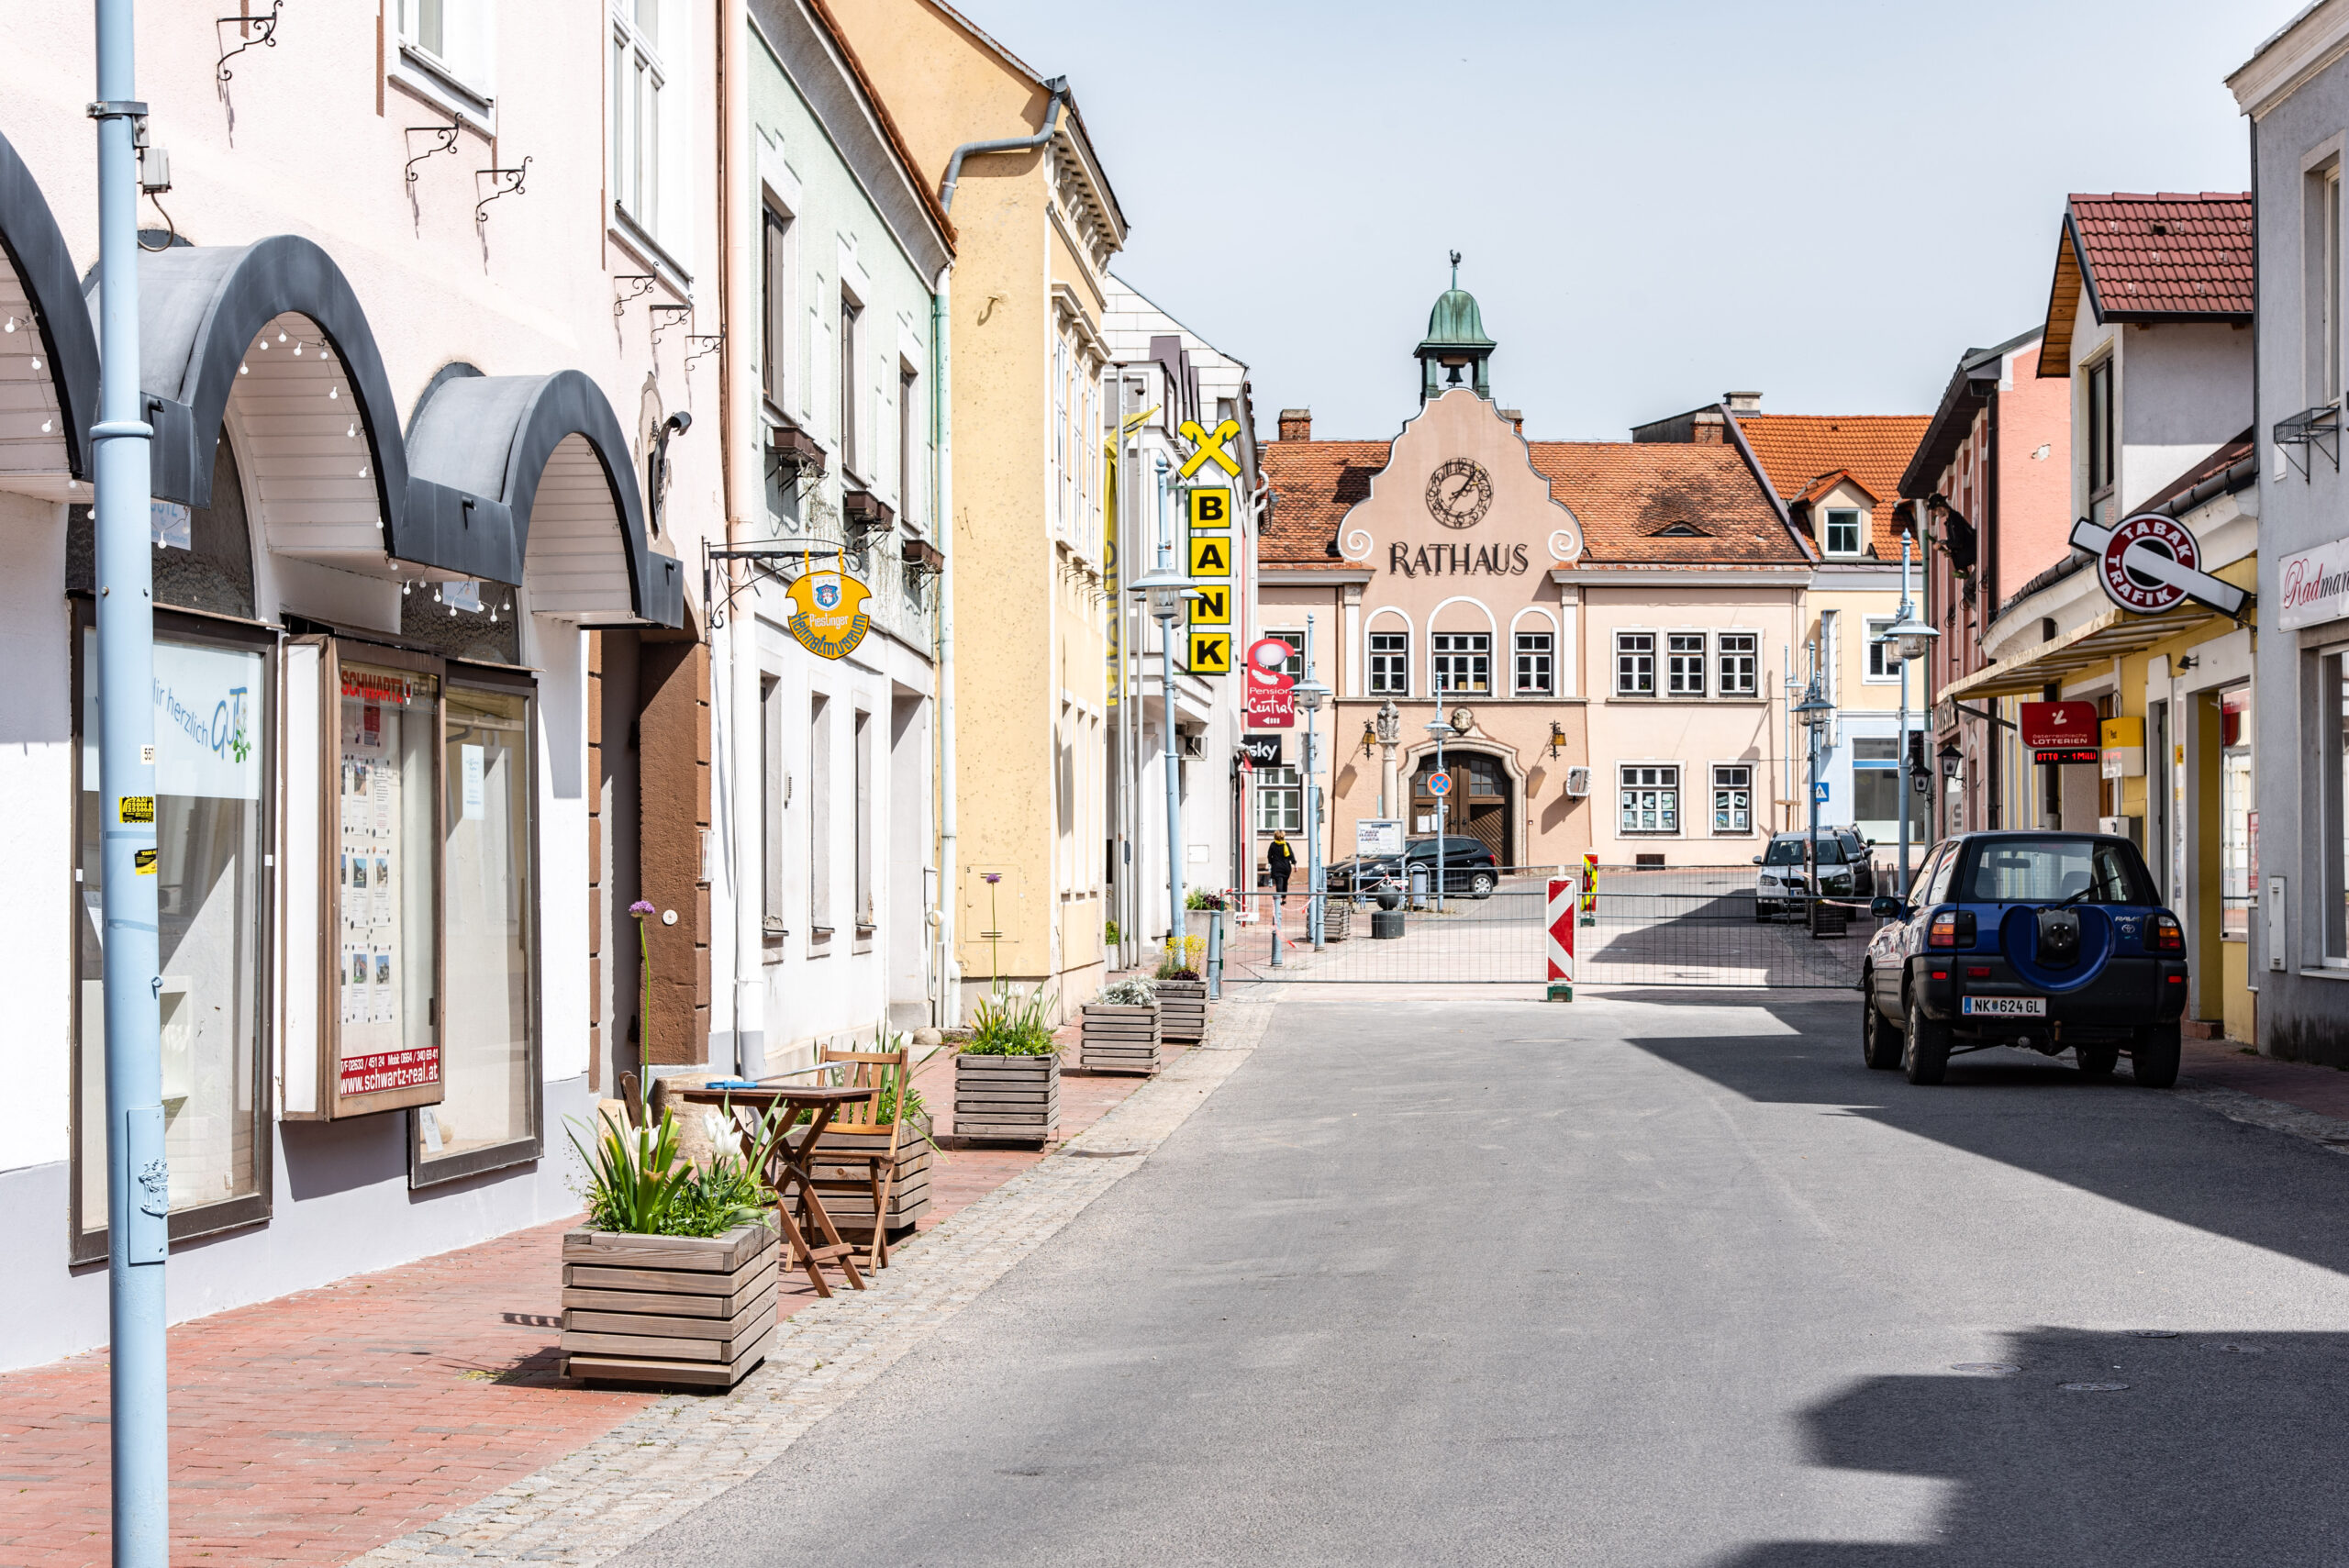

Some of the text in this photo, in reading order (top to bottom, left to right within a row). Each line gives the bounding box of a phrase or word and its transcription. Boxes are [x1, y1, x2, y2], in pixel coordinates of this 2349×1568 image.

[2121, 522, 2191, 559] TABAK
[1389, 541, 1530, 578] RATHAUS
[1197, 496, 1224, 664] BANK
[2108, 555, 2172, 606] TRAFIK
[789, 611, 867, 656] Heimatmuseum
[808, 613, 849, 629] Piestinger
[340, 670, 404, 704] SCHWARTZ
[167, 688, 208, 748] herzlich
[1248, 695, 1294, 715] Central
[1248, 741, 1277, 761] sky
[1975, 999, 2041, 1013] NK 624 GL
[348, 1058, 364, 1072] 02633
[368, 1056, 378, 1068] 451
[378, 1055, 385, 1067] 24
[432, 1048, 439, 1059] 41
[340, 1062, 439, 1095] www.schwartz-real.at
